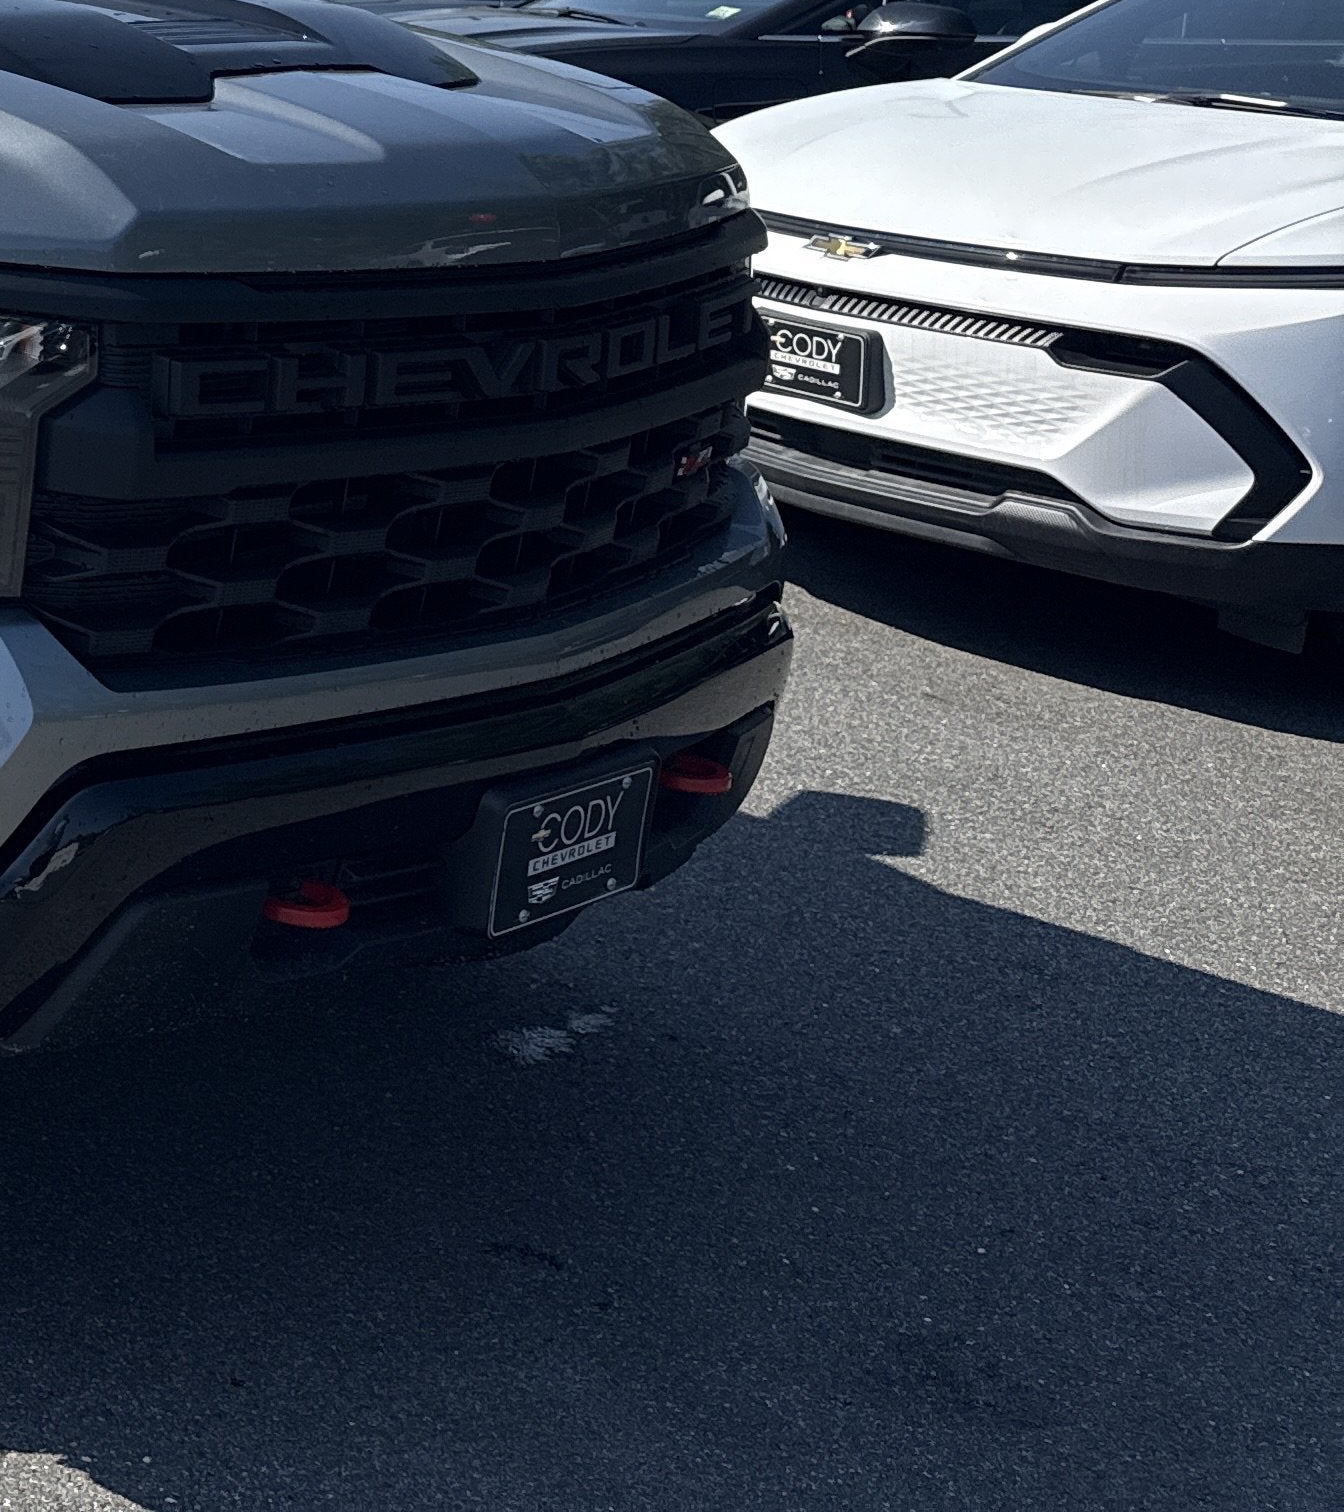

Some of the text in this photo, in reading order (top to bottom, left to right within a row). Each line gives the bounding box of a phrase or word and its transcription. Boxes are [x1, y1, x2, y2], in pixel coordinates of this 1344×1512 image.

[772, 351, 837, 371] CHEVROLET
[774, 329, 842, 363] CODY
[535, 790, 625, 853] CODY
[531, 835, 613, 873] CHEVROLET
[561, 863, 613, 890] CADILLAC
